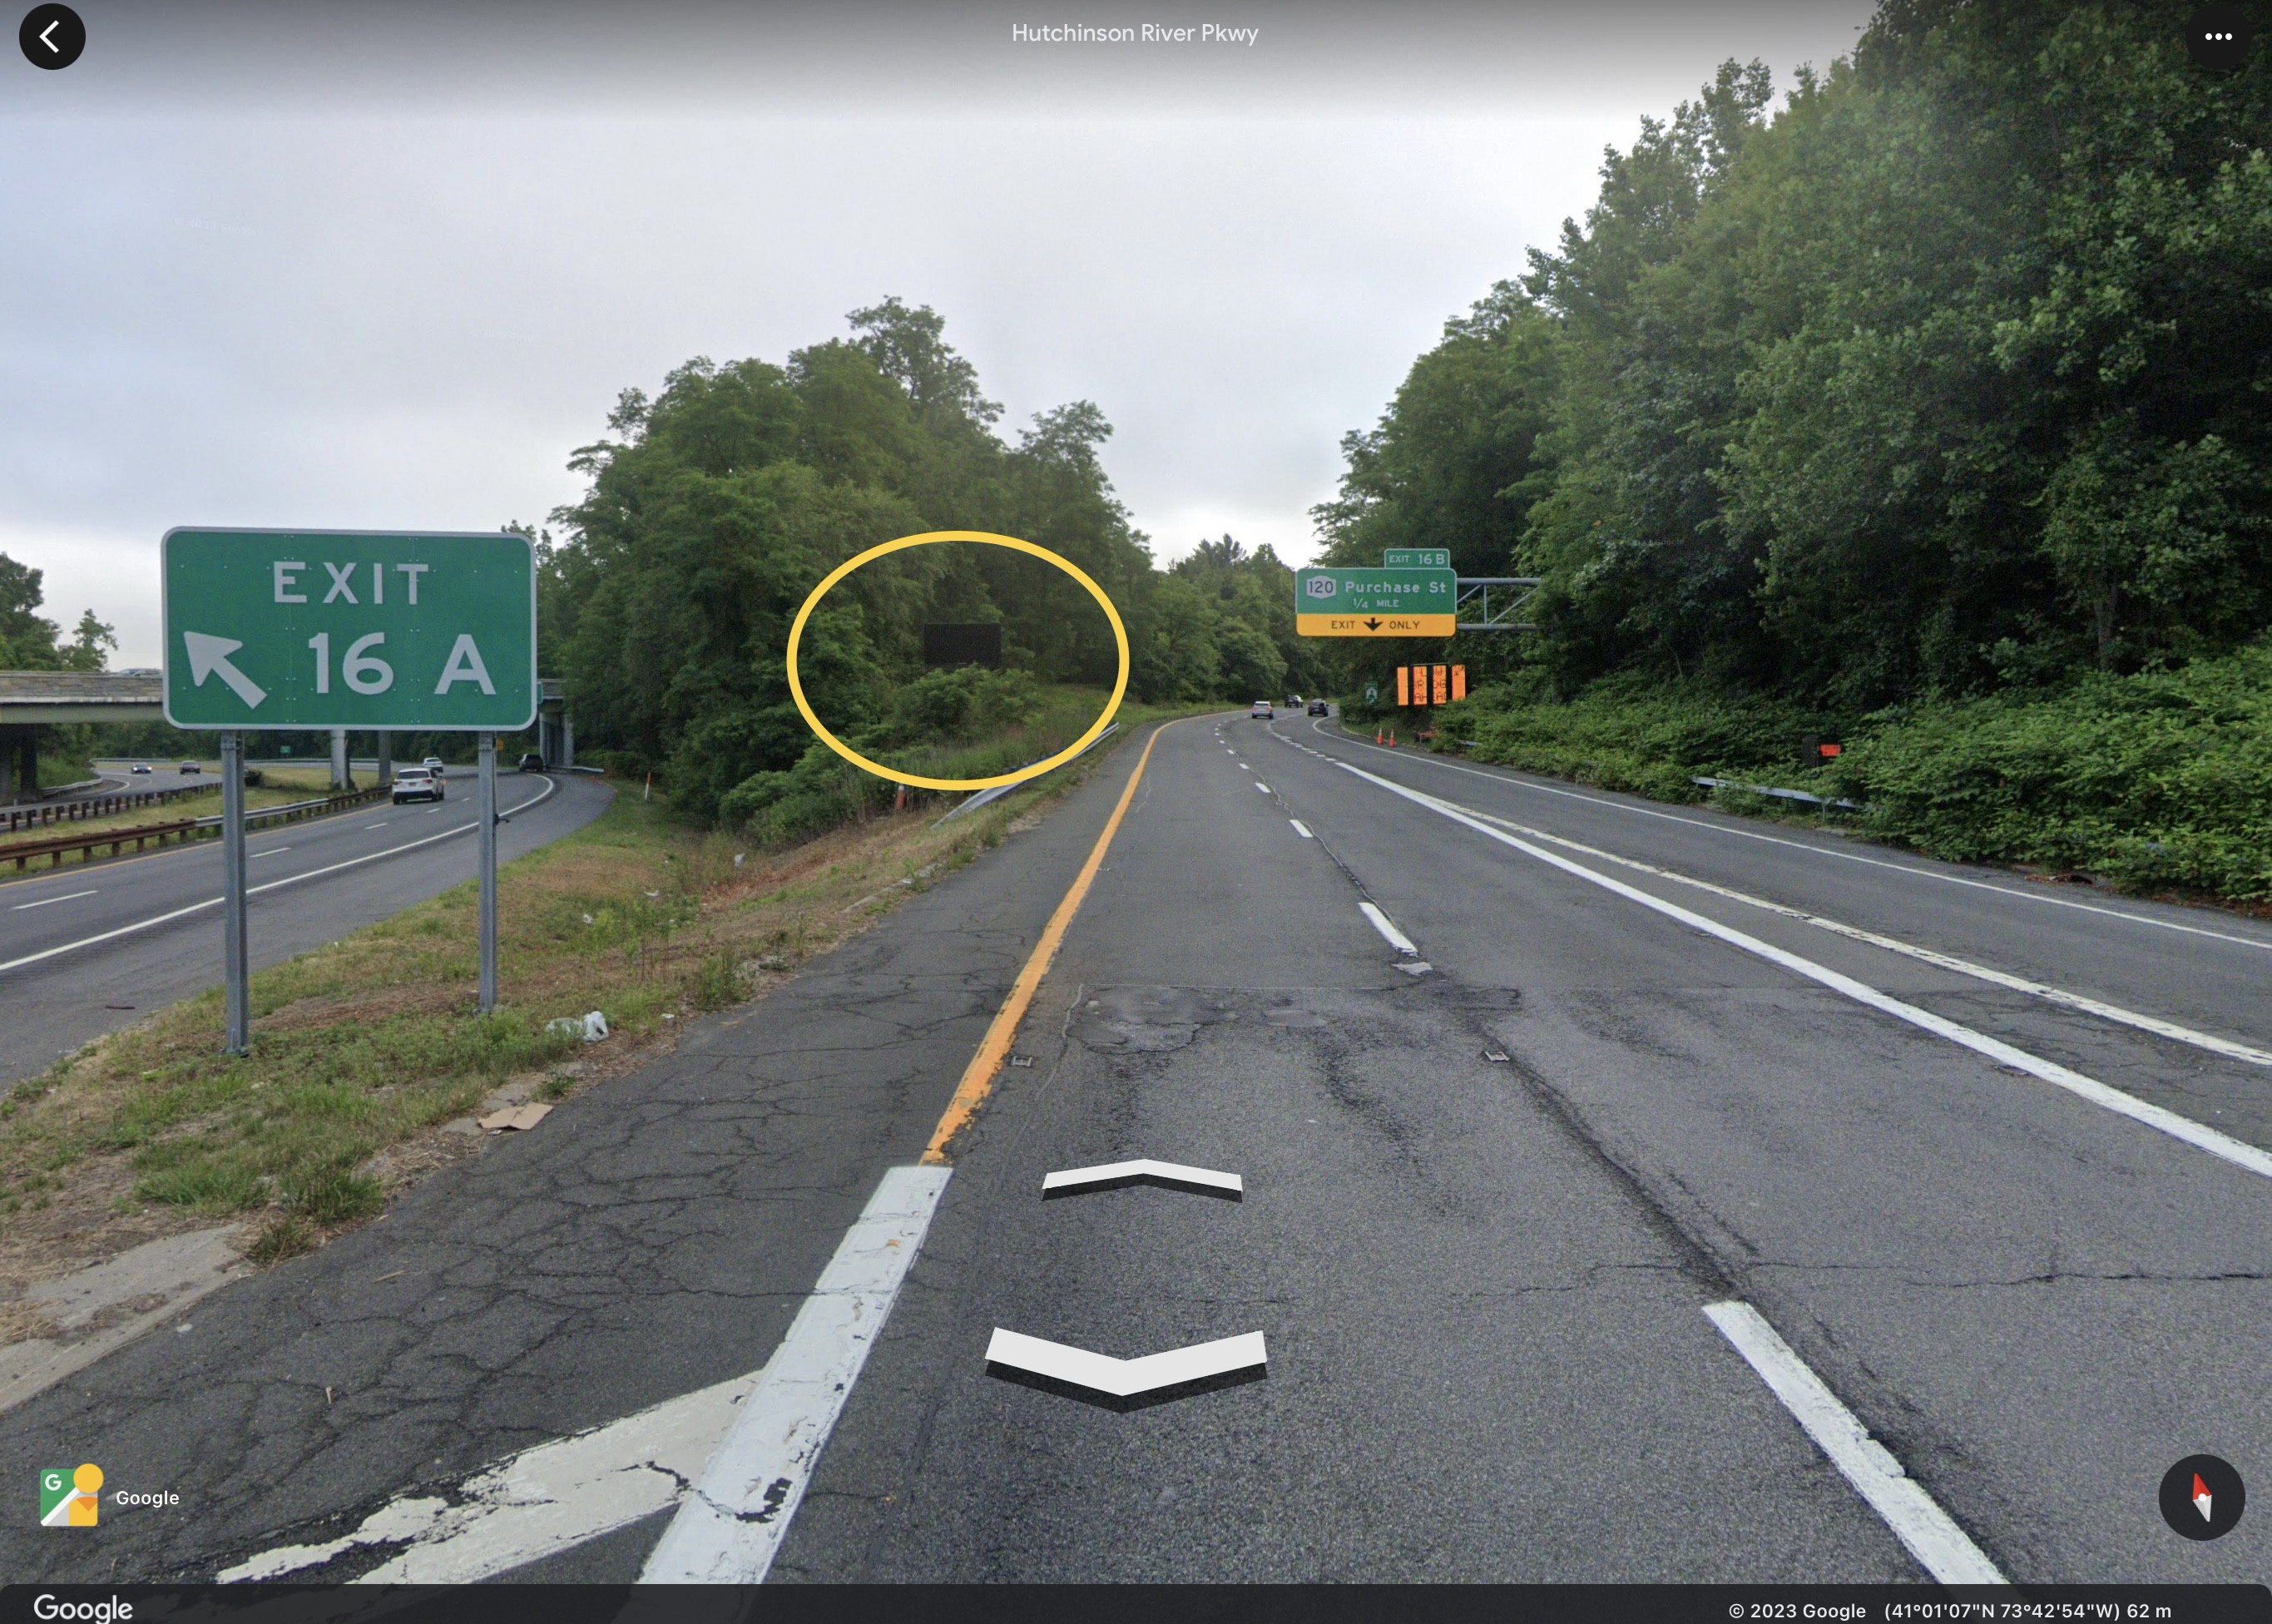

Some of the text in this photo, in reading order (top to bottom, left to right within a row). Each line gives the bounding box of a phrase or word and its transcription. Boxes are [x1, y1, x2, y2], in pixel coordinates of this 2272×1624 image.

[1388, 553, 1445, 565] EXIT 16 B
[273, 561, 429, 605] EXIT
[1309, 581, 1334, 593] 120
[1345, 582, 1446, 593] Purchase St
[1376, 599, 1399, 607] MILE
[1331, 621, 1420, 630] EXIT ONLY
[308, 632, 497, 696] 16 A
